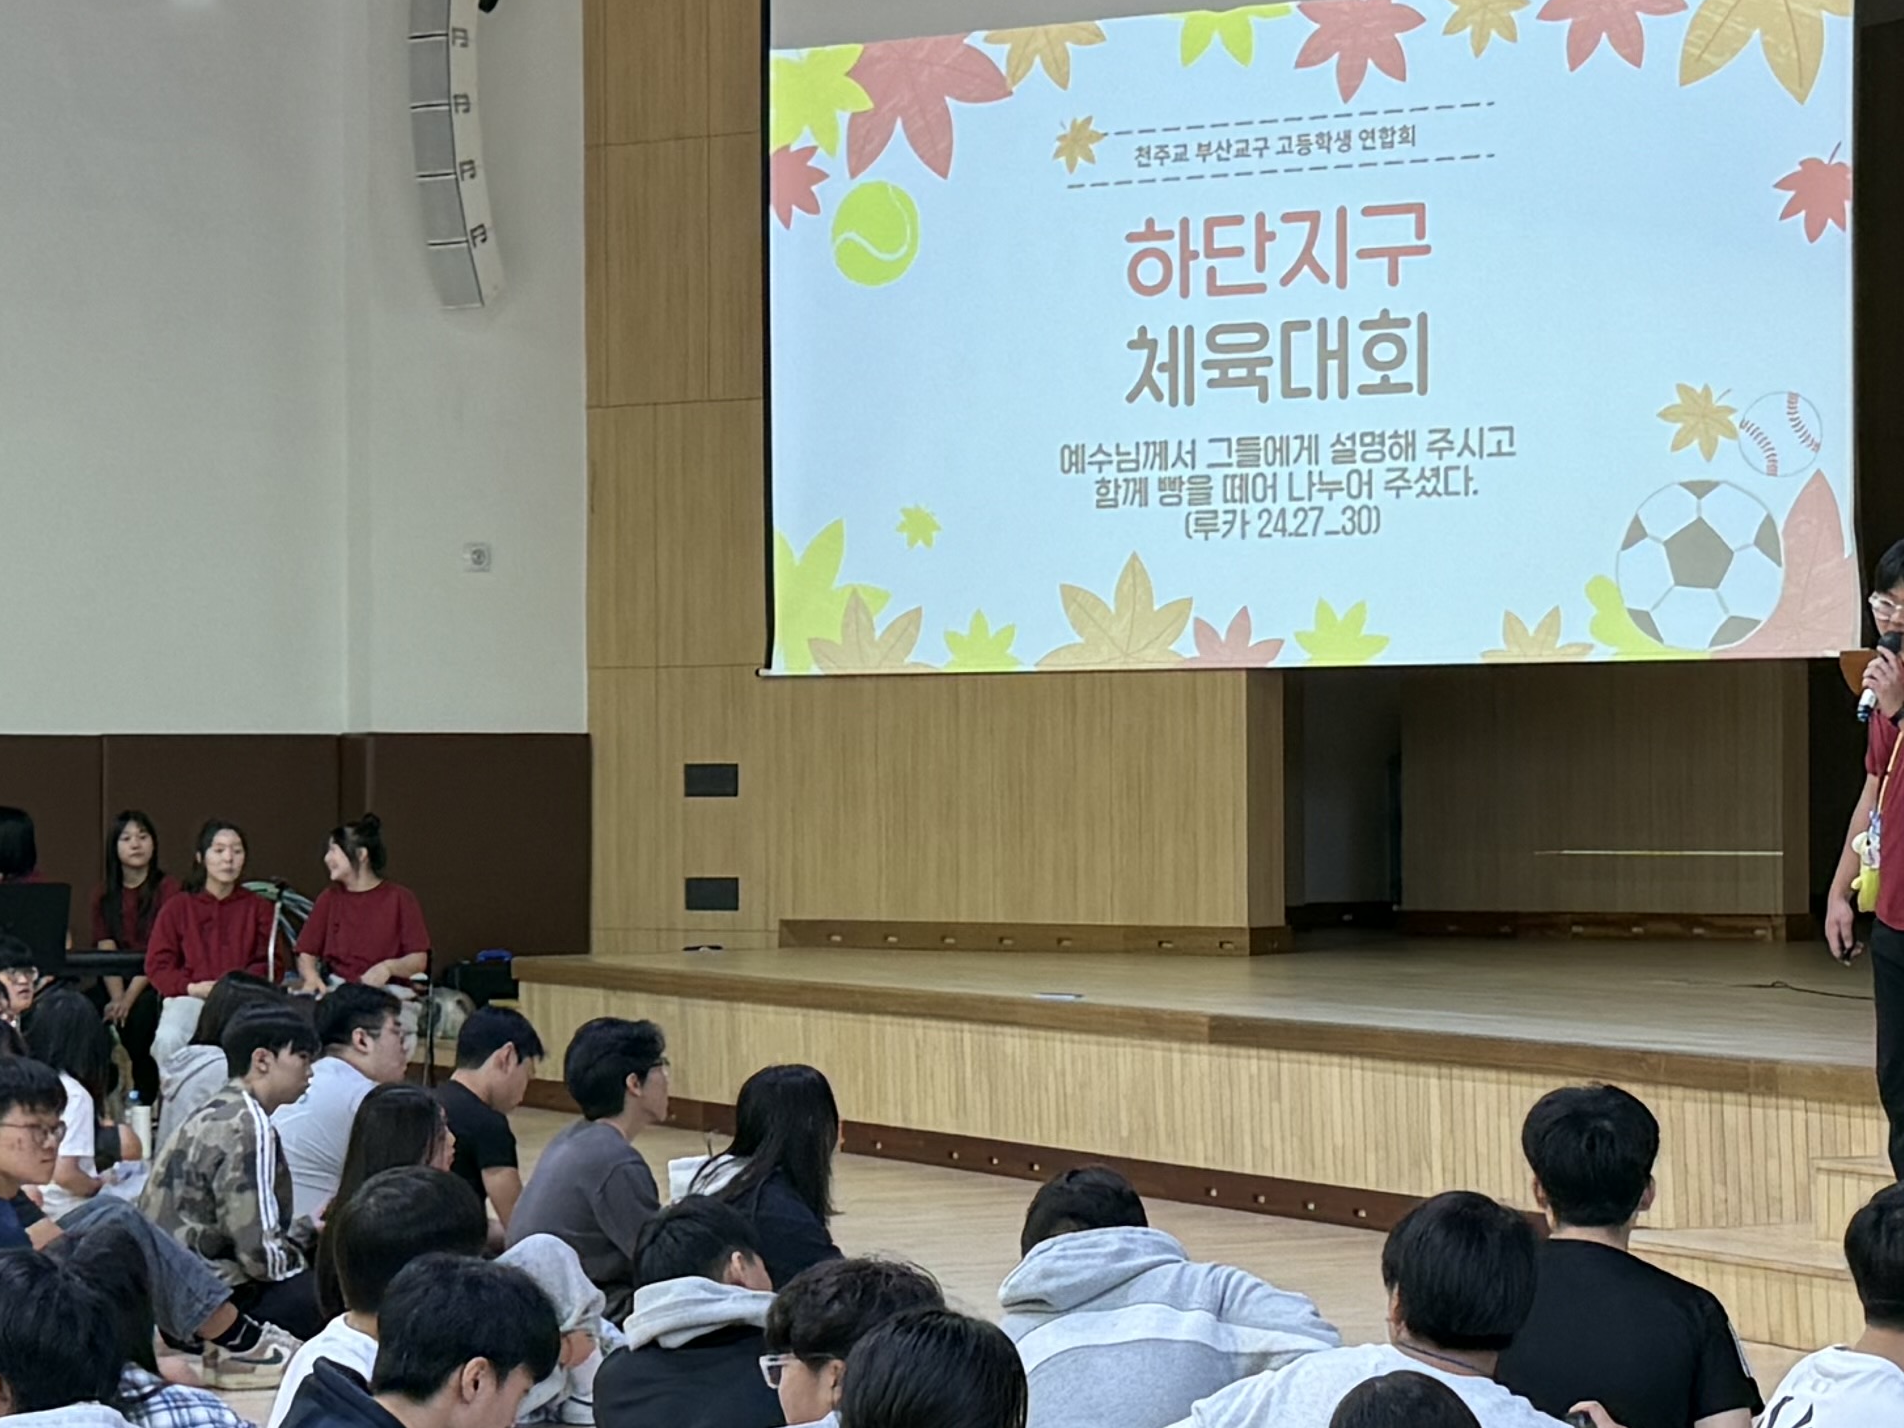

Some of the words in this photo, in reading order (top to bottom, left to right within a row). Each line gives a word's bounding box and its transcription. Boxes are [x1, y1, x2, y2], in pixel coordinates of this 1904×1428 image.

[1133, 143, 1189, 169] 천주교
[1195, 136, 1271, 164] 부산교구
[1275, 128, 1353, 158] 고등학생
[1358, 124, 1417, 153] 연합회
[1124, 202, 1432, 300] 하단지구
[1124, 307, 1428, 409] 체육대회
[1060, 438, 1197, 475] 예수님께서
[1206, 433, 1320, 470] 그들에게
[1329, 428, 1417, 466] 설명해
[1426, 425, 1517, 462] 주시고
[1094, 475, 1149, 509] 함께
[1157, 472, 1214, 507] 빵을
[1222, 471, 1279, 505] 떼어
[1287, 468, 1374, 503] 나누어
[1383, 465, 1479, 500] 주셨다.
[1184, 508, 1251, 542] (루카
[1256, 504, 1381, 540] 24.27_30)
